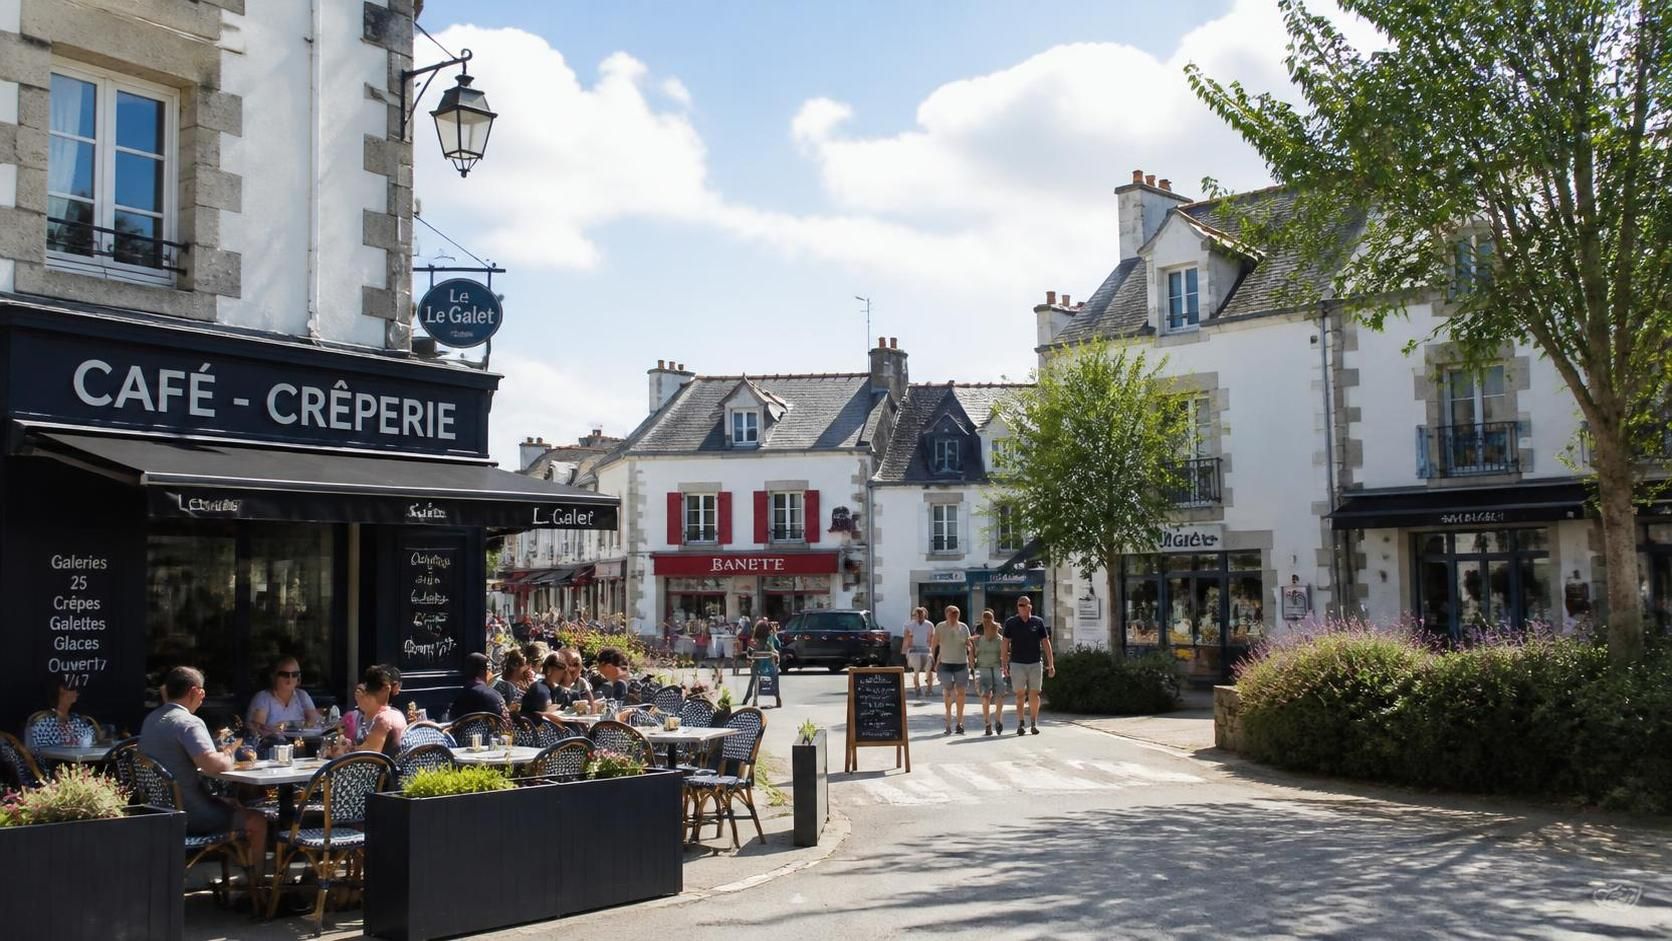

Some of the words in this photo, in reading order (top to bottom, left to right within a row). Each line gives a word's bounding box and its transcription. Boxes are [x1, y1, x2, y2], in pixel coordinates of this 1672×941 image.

[449, 288, 470, 304] Le
[425, 305, 446, 324] Le
[448, 305, 495, 324] Galet
[73, 359, 216, 419] CAFÉ
[267, 379, 457, 440] CRÊPERIE
[51, 554, 108, 570] Galeries
[70, 575, 88, 590] 25
[53, 595, 101, 614] Crêpes
[50, 614, 106, 631] Galettes
[54, 635, 100, 651] Glaces
